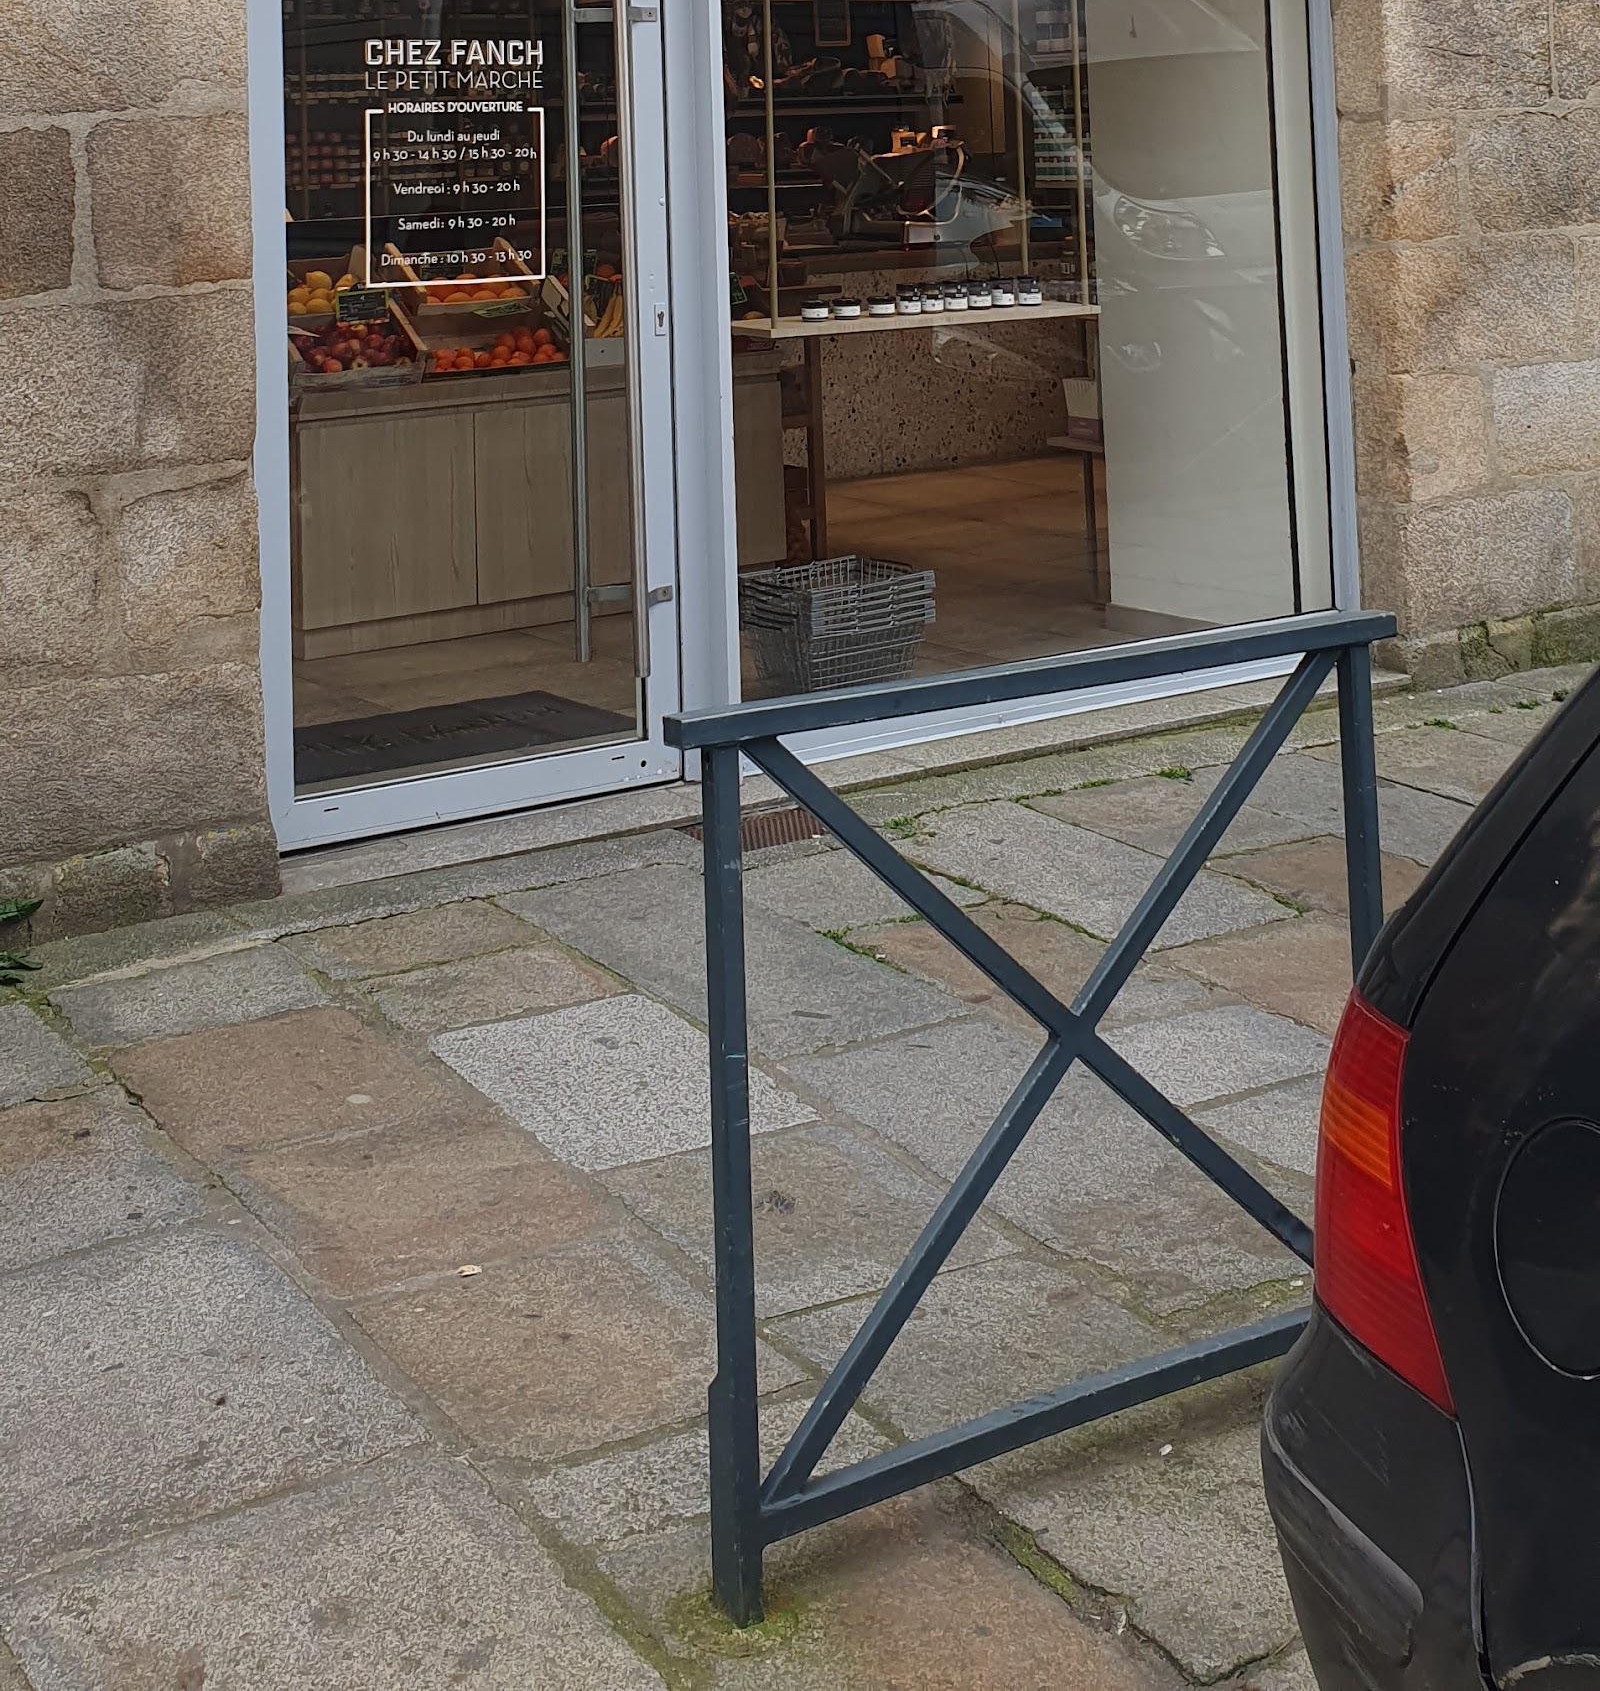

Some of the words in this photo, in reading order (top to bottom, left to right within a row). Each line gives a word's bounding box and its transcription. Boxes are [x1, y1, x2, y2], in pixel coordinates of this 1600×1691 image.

[365, 39, 442, 66] CHEZ
[451, 39, 543, 66] FANCH
[365, 71, 388, 90] LE
[396, 71, 450, 89] PETIT
[457, 64, 543, 89] MARCHÉ
[388, 102, 445, 113] HORAIRES
[447, 101, 523, 113] D'OUVERTURE
[408, 130, 423, 142] Du
[427, 130, 454, 142] lundi
[457, 133, 470, 141] au
[472, 129, 500, 144] jeudi
[373, 150, 380, 162] 9
[383, 148, 390, 159] h
[392, 150, 408, 161] 30
[418, 150, 429, 160] 14
[432, 147, 439, 158] h
[441, 149, 457, 161] 30
[469, 149, 479, 159] 15
[482, 147, 488, 158] h
[490, 148, 505, 159] 30
[453, 184, 460, 194] 9
[463, 182, 470, 193] h
[471, 183, 488, 194] 30
[496, 182, 511, 192] 20
[513, 180, 520, 191] h
[448, 218, 455, 229] 9
[458, 216, 464, 227] h
[467, 217, 483, 229] 30
[492, 217, 507, 227] 20
[509, 214, 516, 226] h
[381, 252, 438, 266] Dimanche
[447, 254, 459, 263] 10
[462, 251, 468, 262] h
[471, 253, 486, 264] 30
[496, 252, 506, 262] 13
[508, 249, 515, 260] h
[518, 250, 532, 260] 30
